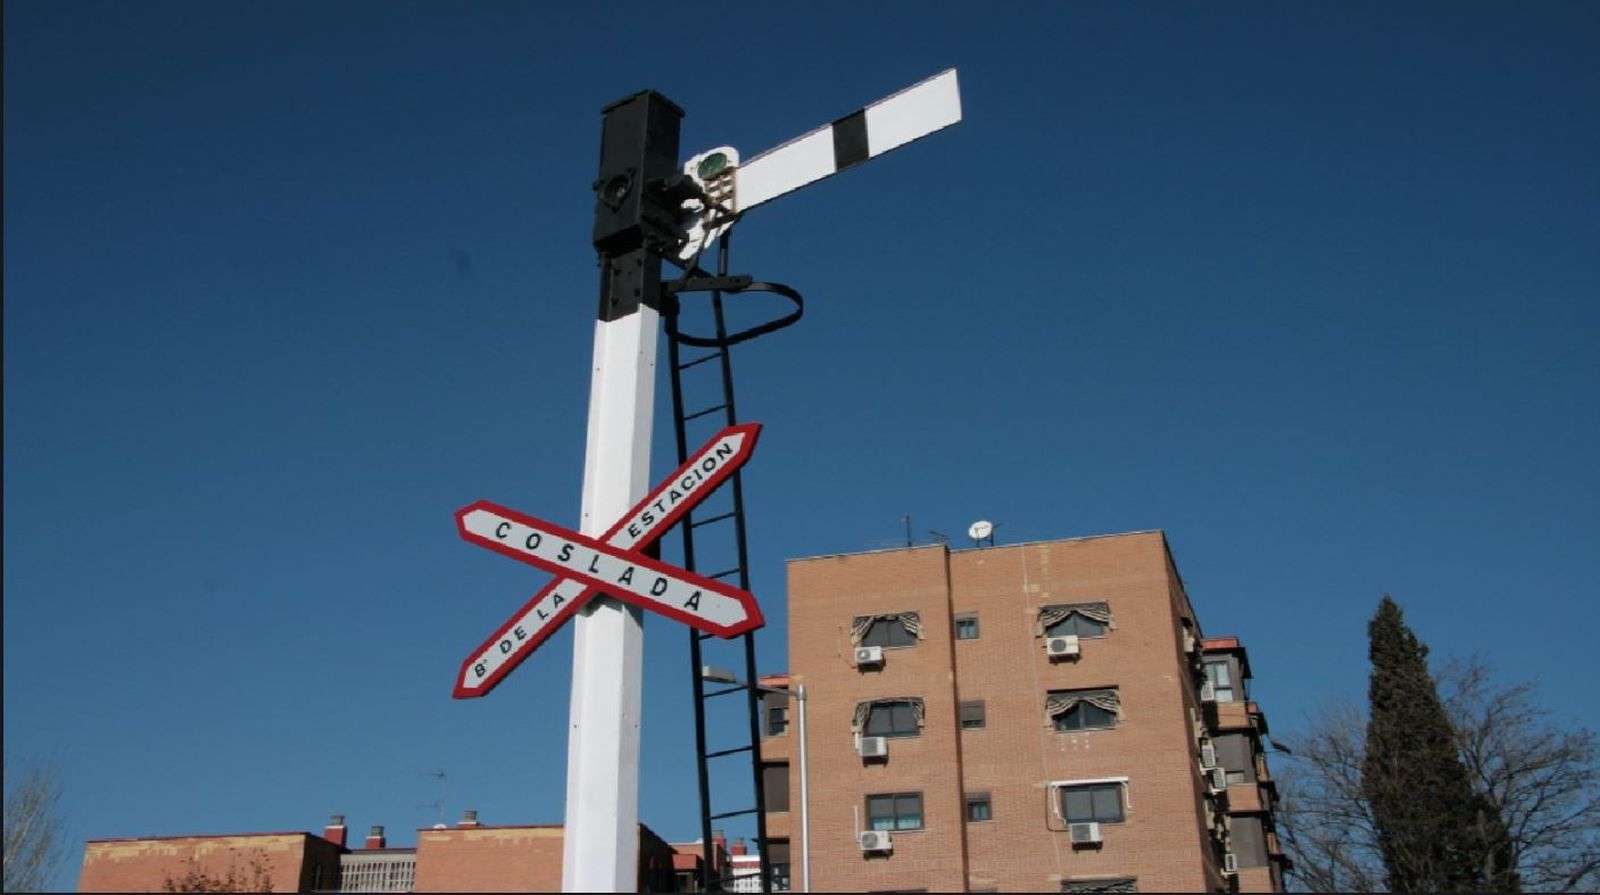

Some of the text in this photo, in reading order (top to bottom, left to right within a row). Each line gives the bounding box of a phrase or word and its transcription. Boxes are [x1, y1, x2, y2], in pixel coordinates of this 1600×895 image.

[495, 521, 704, 612] COSLADA
[499, 626, 527, 654] DE
[536, 593, 565, 620] LA
[627, 442, 733, 538] ESTACION
